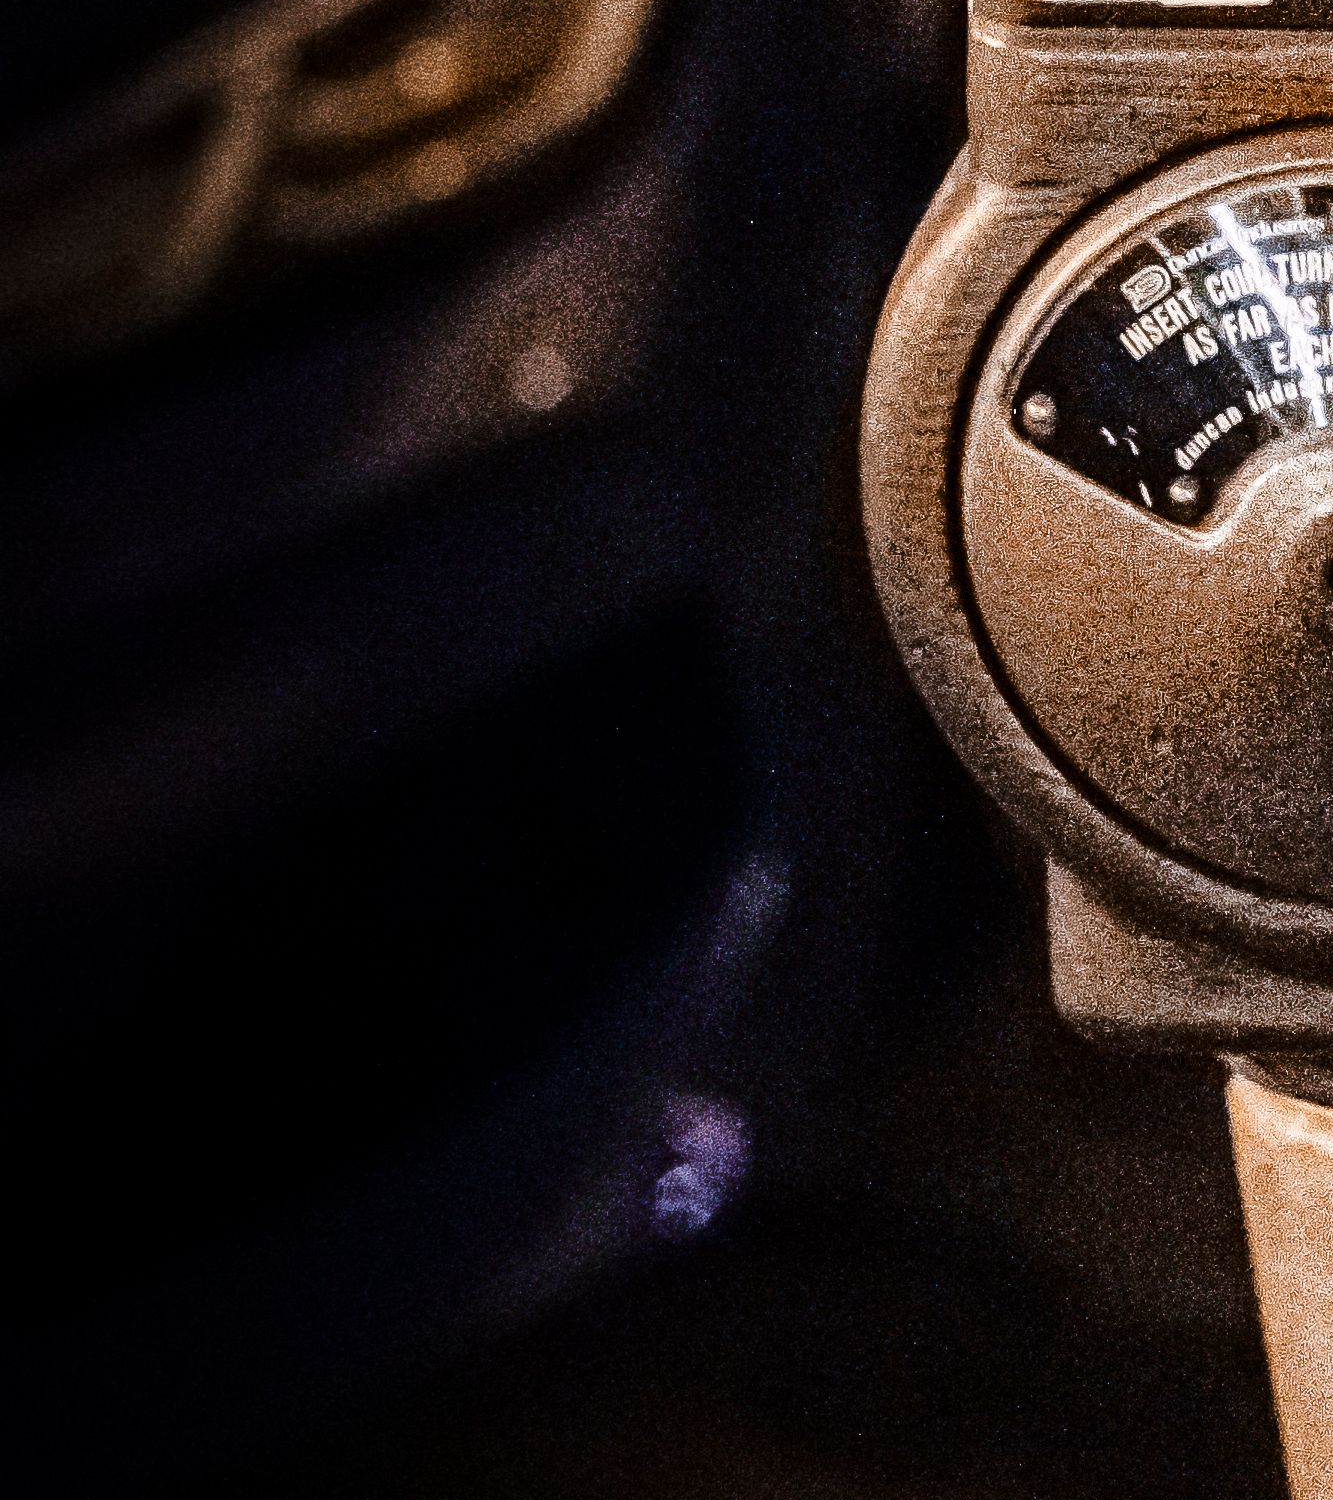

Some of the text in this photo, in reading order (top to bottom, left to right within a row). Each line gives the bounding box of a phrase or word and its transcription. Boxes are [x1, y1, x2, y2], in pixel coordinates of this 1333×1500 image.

[1119, 288, 1200, 362] INSERT
[1183, 323, 1219, 367] AS
[1223, 303, 1272, 348] FAR
